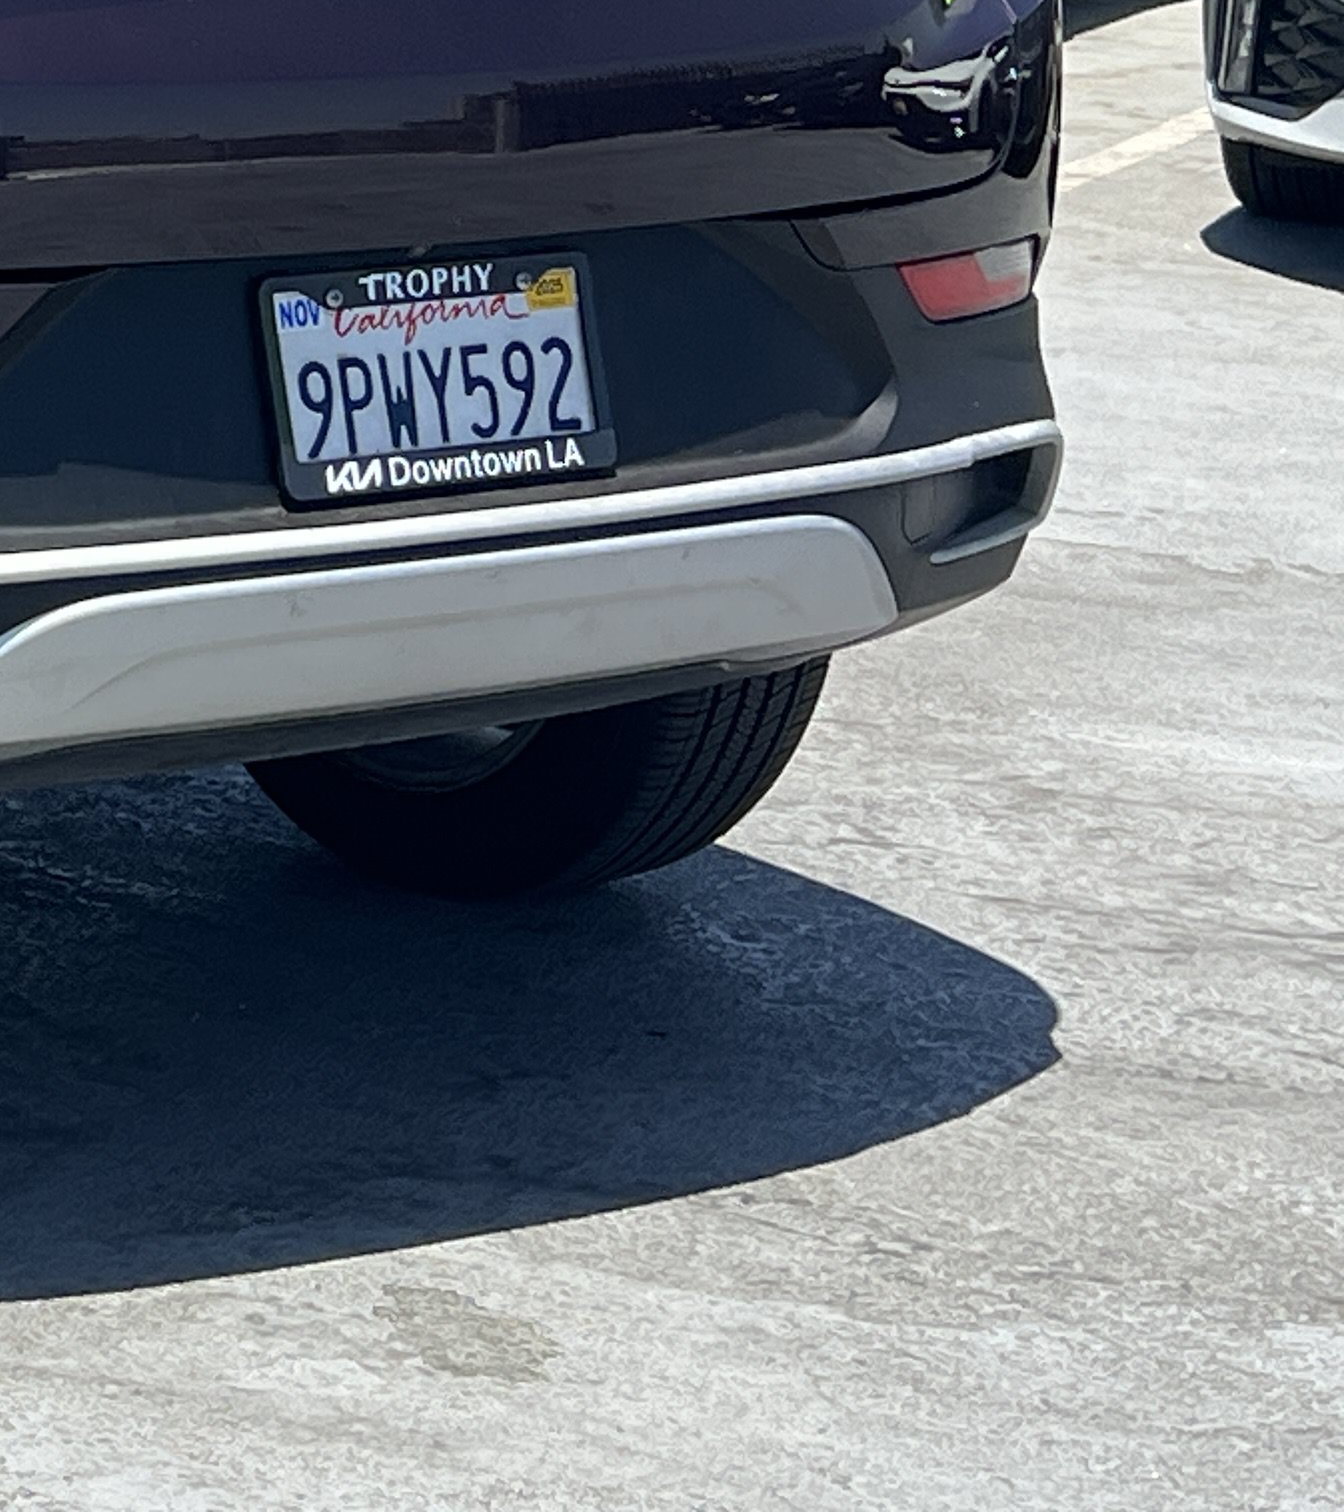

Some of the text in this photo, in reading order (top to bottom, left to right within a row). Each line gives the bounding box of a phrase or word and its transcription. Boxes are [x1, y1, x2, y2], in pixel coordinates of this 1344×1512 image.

[358, 262, 495, 302] TROPHY
[278, 298, 320, 330] NOV
[334, 294, 531, 345] California
[297, 336, 583, 459] 9PWY592
[389, 447, 542, 486] Downtown
[545, 437, 585, 470] LA
